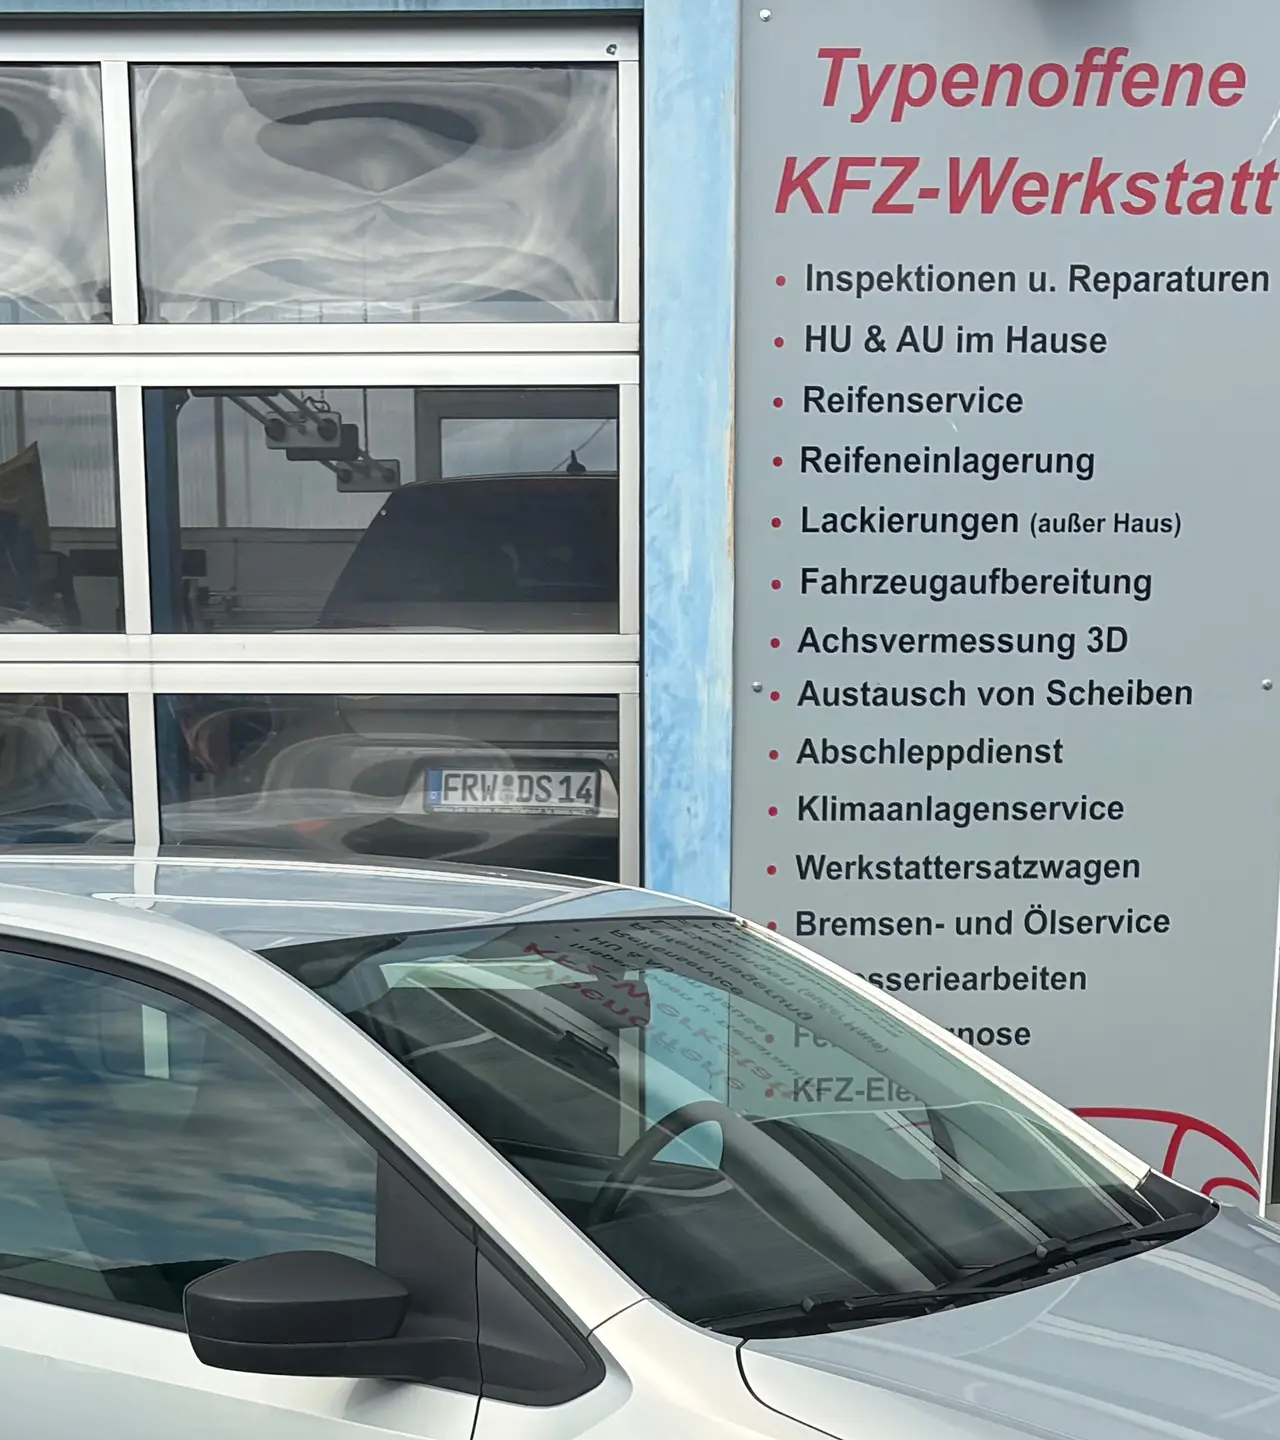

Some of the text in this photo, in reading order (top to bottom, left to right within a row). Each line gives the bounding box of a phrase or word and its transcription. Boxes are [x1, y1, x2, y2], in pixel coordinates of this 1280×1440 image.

[817, 47, 1247, 123] Typenoffene
[774, 156, 1280, 215] KFZ-Werkstatt
[807, 264, 1268, 299] Inspektionen u. Reparaturen
[806, 325, 1106, 353] HU & AU im Hause
[804, 386, 1023, 413] Reifenservice
[801, 446, 1094, 480] Reifeneinlagerung
[802, 506, 1181, 540] Lackierungen (außer Haus)
[802, 568, 1151, 601] Fahrzeugaufbereitung
[797, 626, 1127, 660] Achsvermessung 3D
[797, 679, 1192, 706] Austausch von Scheiben
[796, 738, 1063, 770] Abschleppdienst
[443, 773, 497, 801] FRW
[516, 774, 552, 802] DS
[558, 775, 593, 803] 14
[799, 795, 1124, 828] Klimaanlagenservice
[796, 855, 1139, 885] Werkstattersatzwagen
[797, 904, 1170, 936] Bremsen- und Ölservice
[856, 965, 1086, 991] sseriearbeiten
[793, 1077, 919, 1103] KFZ-Ele
